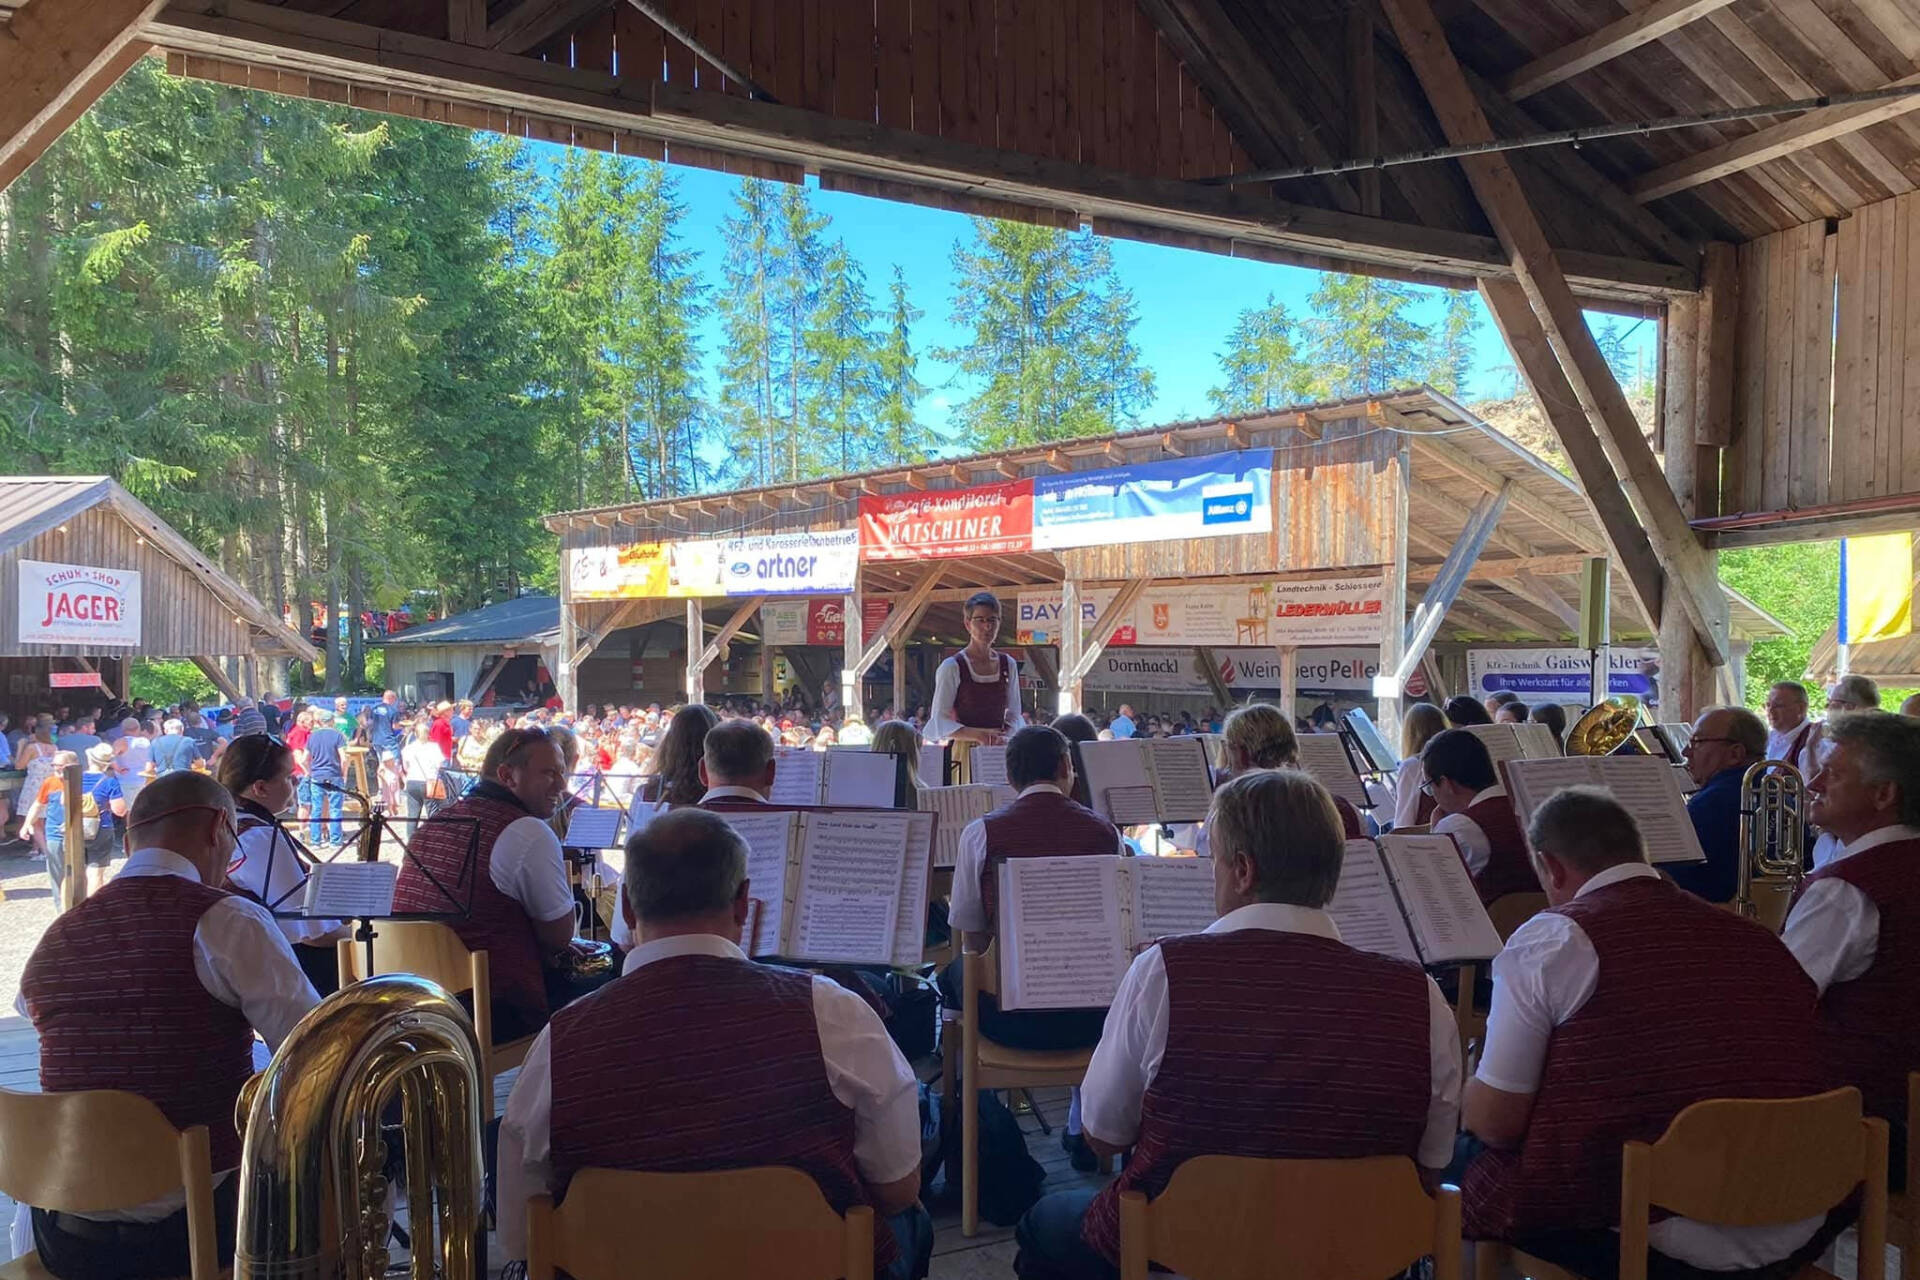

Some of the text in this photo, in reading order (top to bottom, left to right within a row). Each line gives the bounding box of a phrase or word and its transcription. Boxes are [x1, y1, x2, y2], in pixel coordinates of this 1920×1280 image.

[1207, 505, 1235, 515] Allianz
[888, 515, 1003, 544] MATSCHINER
[757, 553, 817, 578] artner
[46, 569, 120, 587] SCHUH SHOP
[1277, 583, 1327, 593] Landtechnik
[1335, 582, 1382, 591] Schlossere
[1021, 603, 1096, 620] BAYR
[1276, 600, 1382, 617] LEDERMÜLLER
[1108, 658, 1178, 673] Dornhackl
[1546, 654, 1641, 669] Gaiswkler
[1239, 661, 1327, 682] Weinerg
[1500, 678, 1517, 687] Ihre
[1518, 678, 1559, 687] Werkstatt
[1561, 677, 1574, 687] für
[1576, 678, 1591, 687] alle
